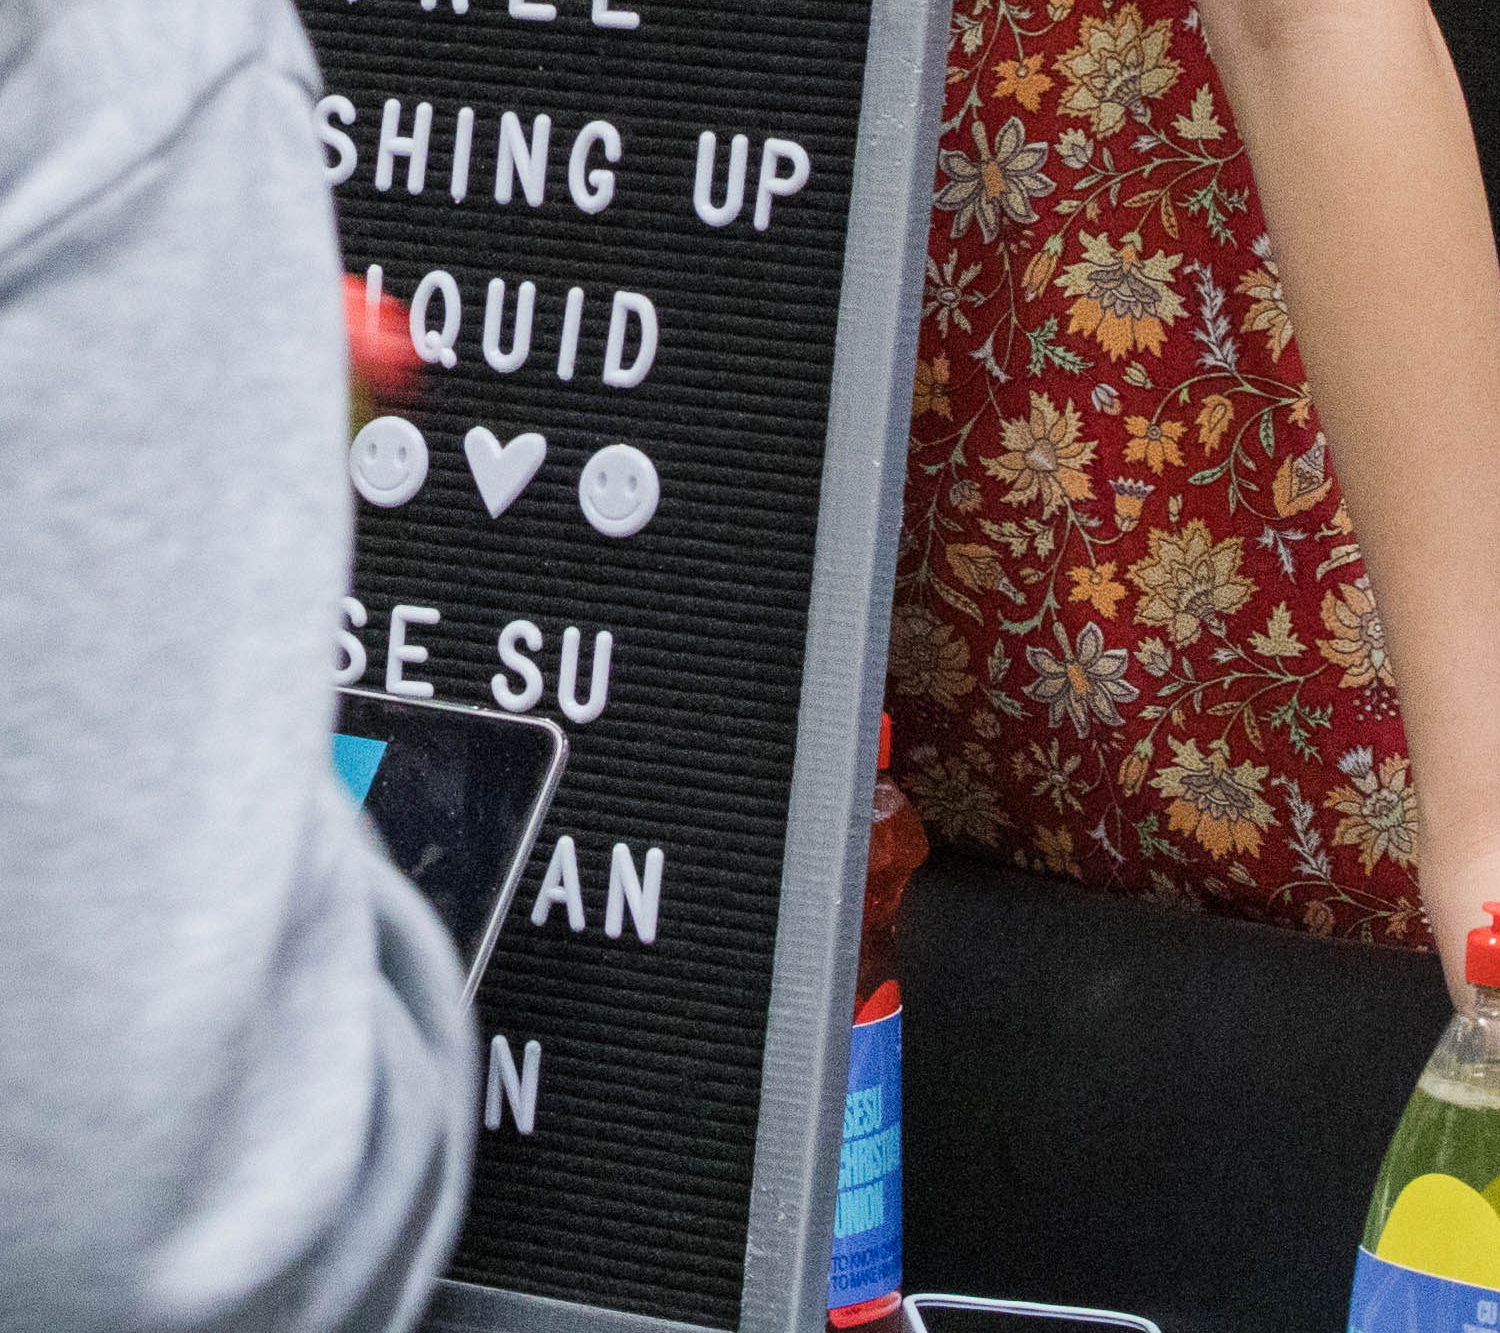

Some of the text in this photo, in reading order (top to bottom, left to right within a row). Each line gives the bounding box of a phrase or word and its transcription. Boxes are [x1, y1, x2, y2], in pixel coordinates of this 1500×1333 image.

[316, 94, 811, 231] SHING UP
[366, 263, 658, 389] IQUID
[335, 596, 613, 724] SE SU
[530, 835, 665, 944] AN
